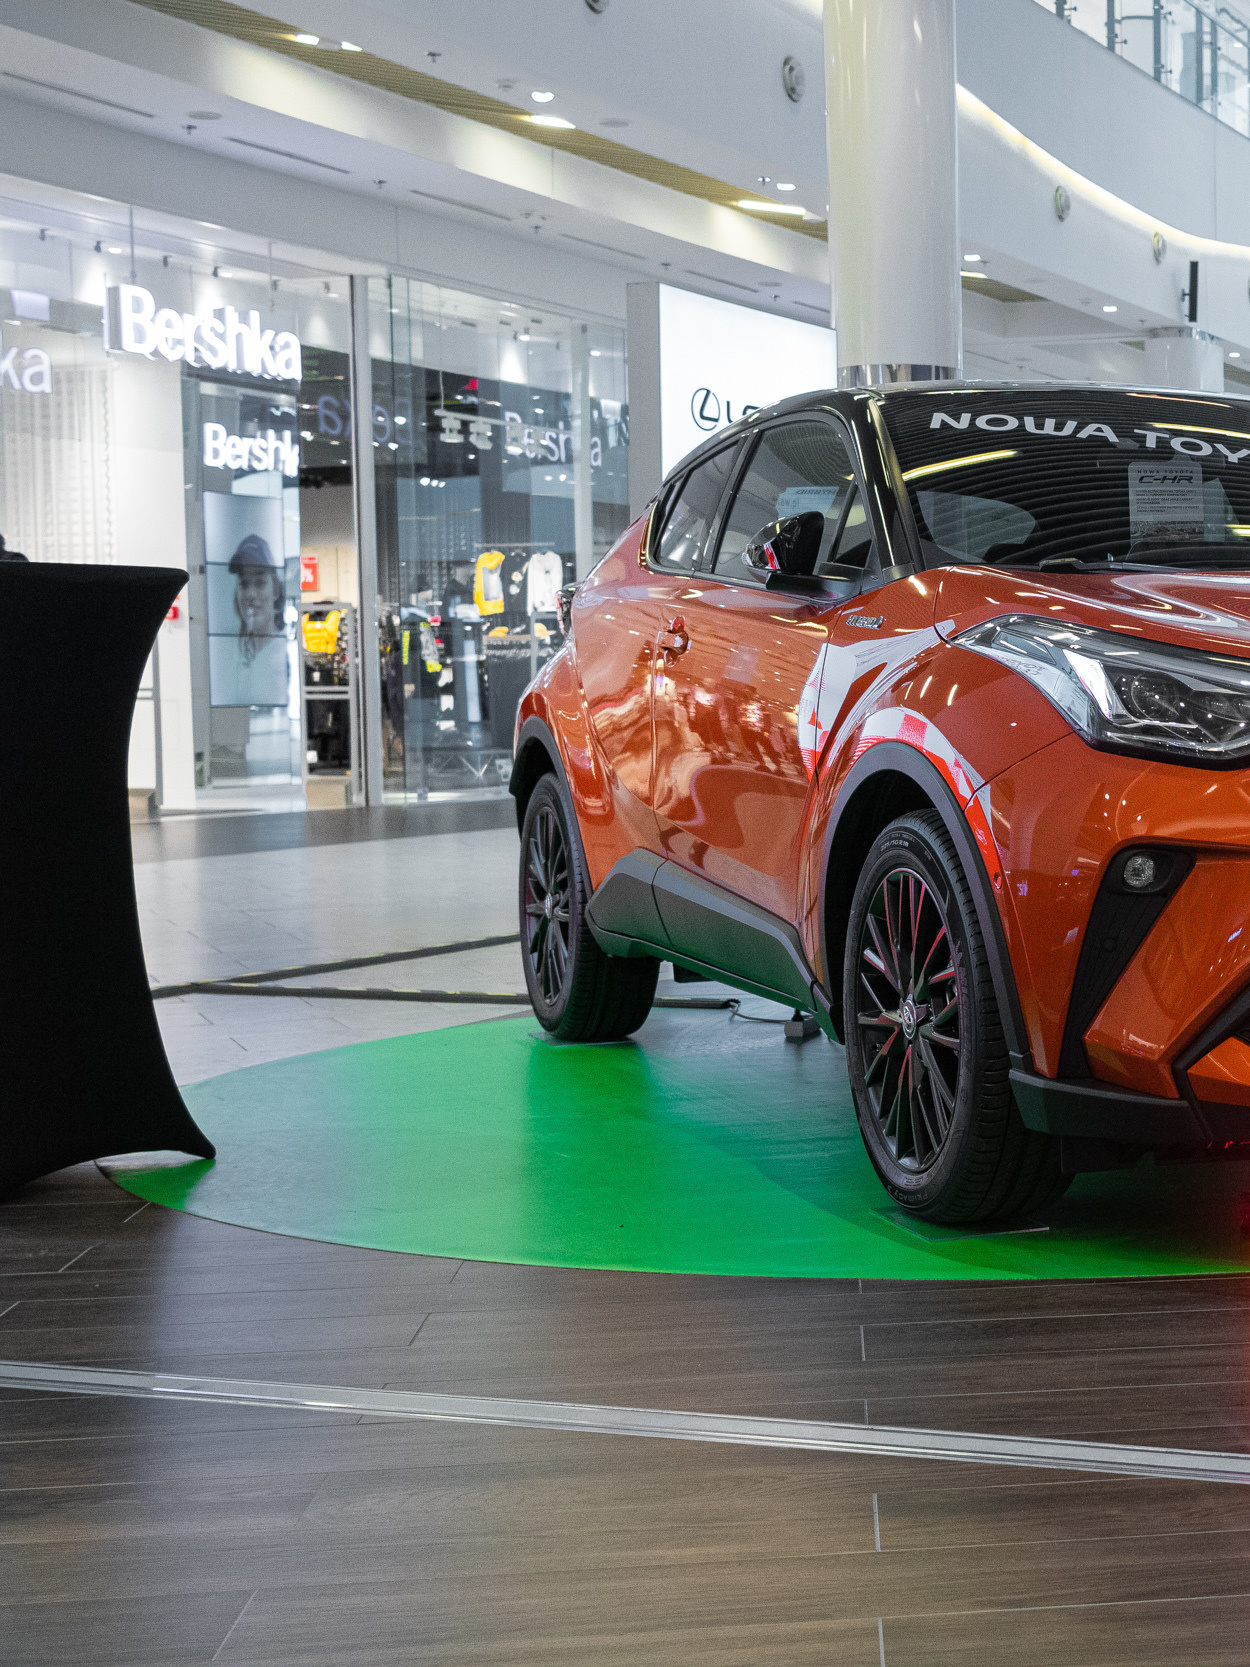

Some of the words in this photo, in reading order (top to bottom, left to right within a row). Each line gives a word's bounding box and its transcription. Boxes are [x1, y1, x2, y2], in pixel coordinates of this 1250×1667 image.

[118, 283, 303, 384] Bershka
[929, 412, 1121, 444] NOWA
[1138, 475, 1194, 484] C-HR
